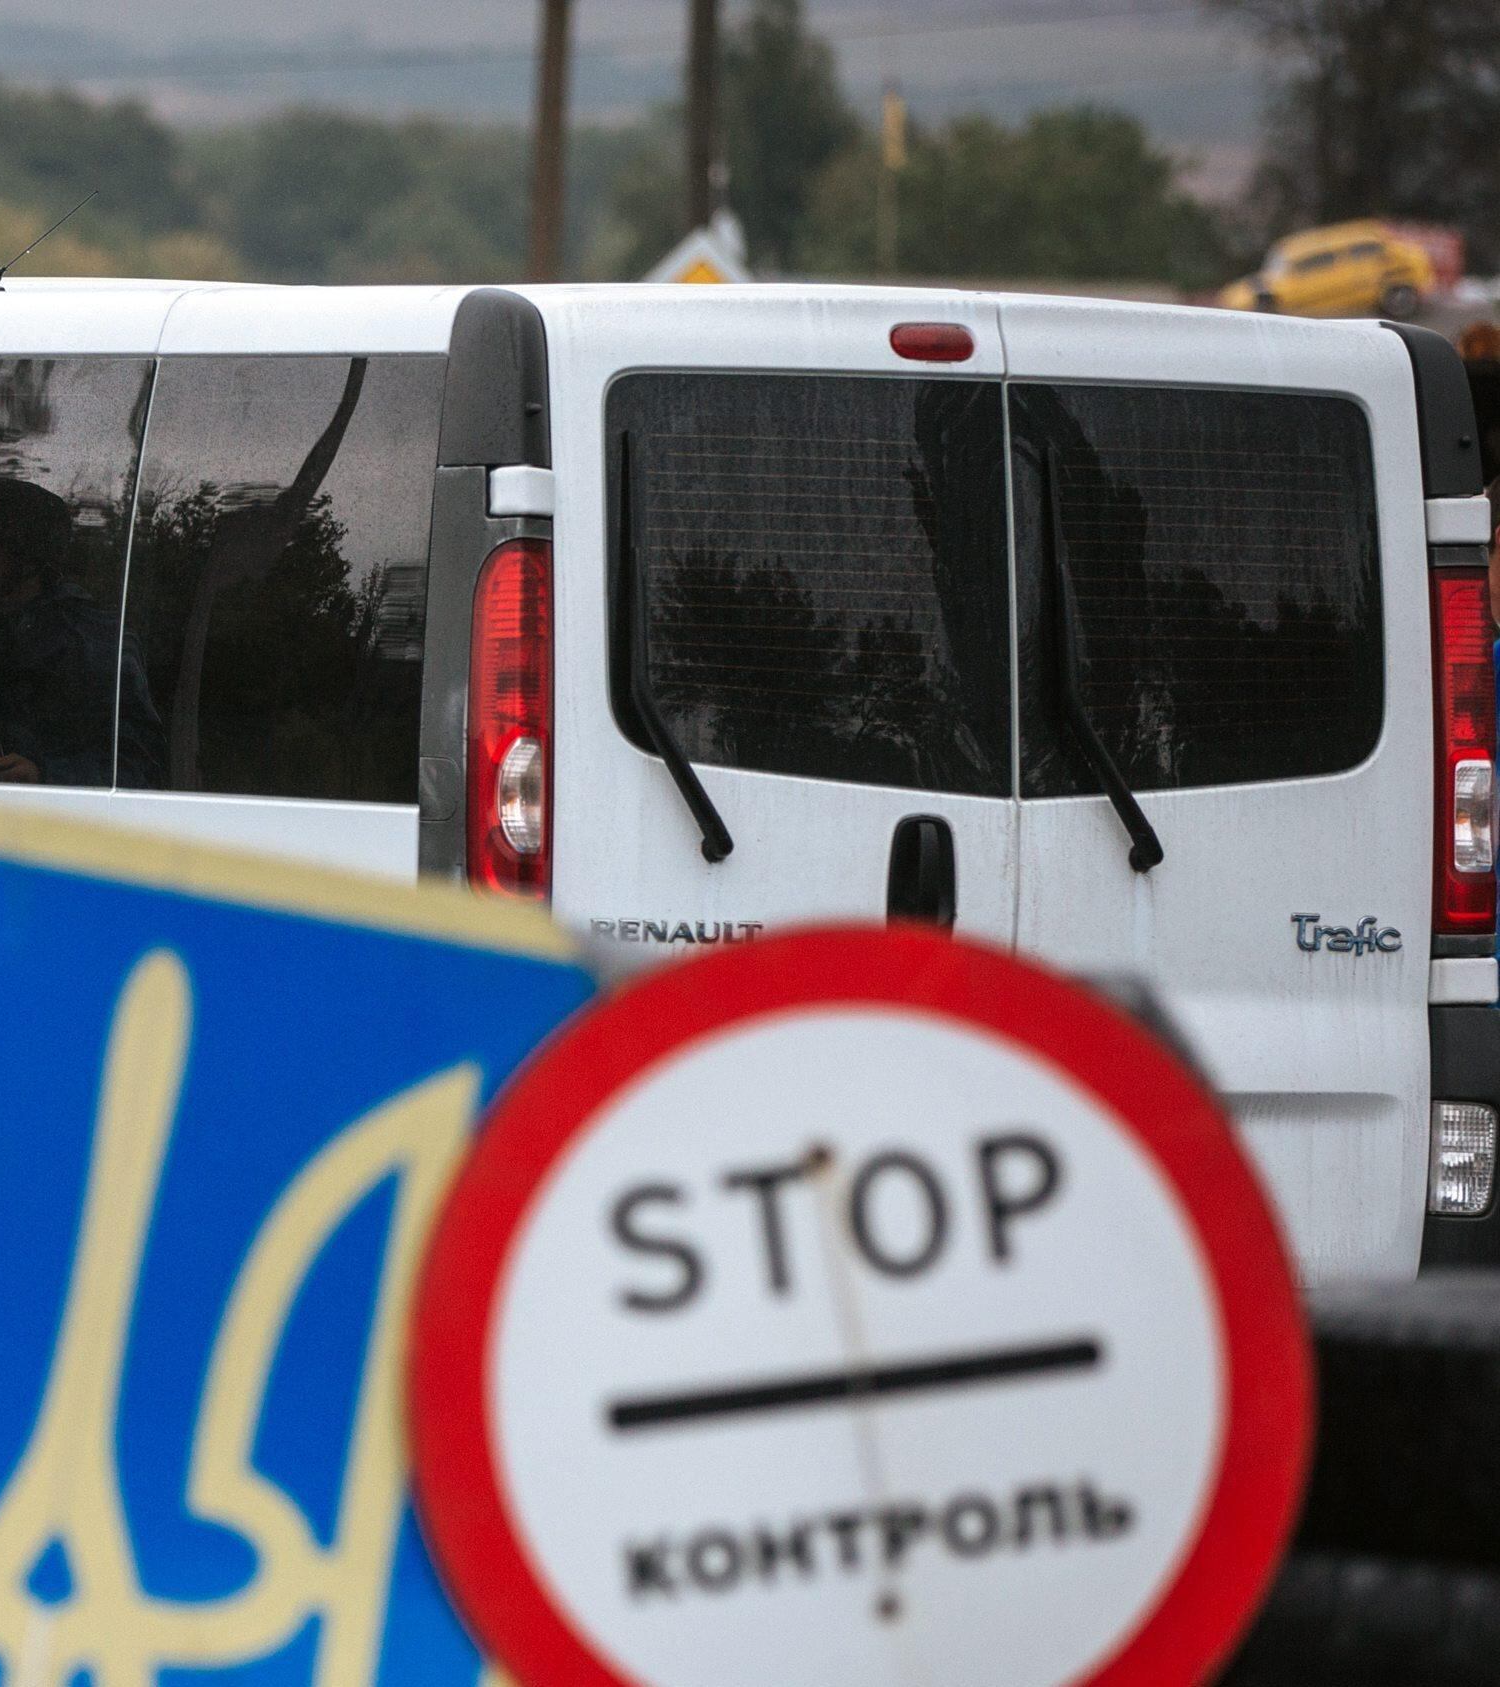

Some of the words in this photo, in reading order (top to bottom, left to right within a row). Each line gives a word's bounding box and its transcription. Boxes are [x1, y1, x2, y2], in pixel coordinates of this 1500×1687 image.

[590, 917, 764, 944] RENAULT
[1290, 912, 1403, 956] Trafic
[608, 1129, 1063, 1316] STOP
